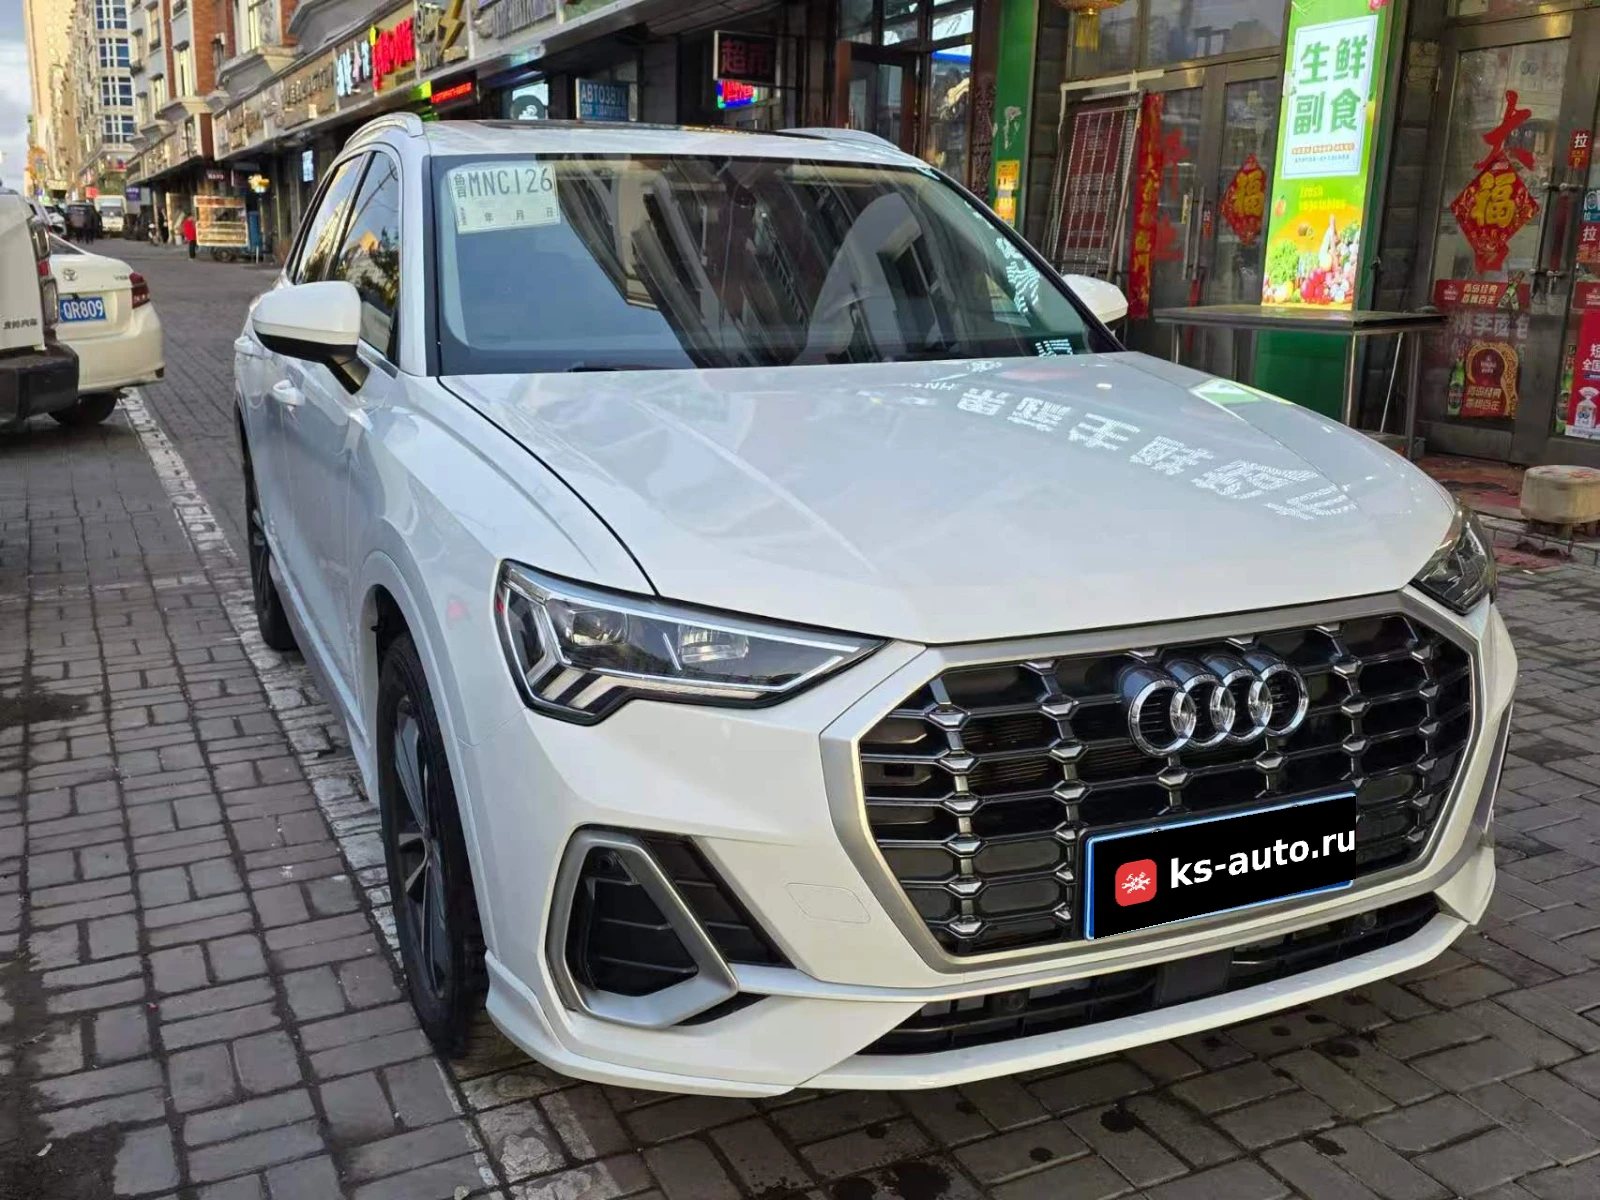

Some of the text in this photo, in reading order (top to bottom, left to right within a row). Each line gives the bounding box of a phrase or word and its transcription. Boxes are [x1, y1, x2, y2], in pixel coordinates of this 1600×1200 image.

[721, 38, 773, 76] 超市
[1299, 34, 1368, 85] 生鲜
[1293, 87, 1361, 136] 副食
[1473, 89, 1535, 172] 大
[1574, 133, 1588, 149] 拉
[454, 168, 553, 198] 鲁MNC126
[1233, 170, 1266, 218] 福
[1470, 171, 1517, 229] 福
[1583, 225, 1597, 242] 拉
